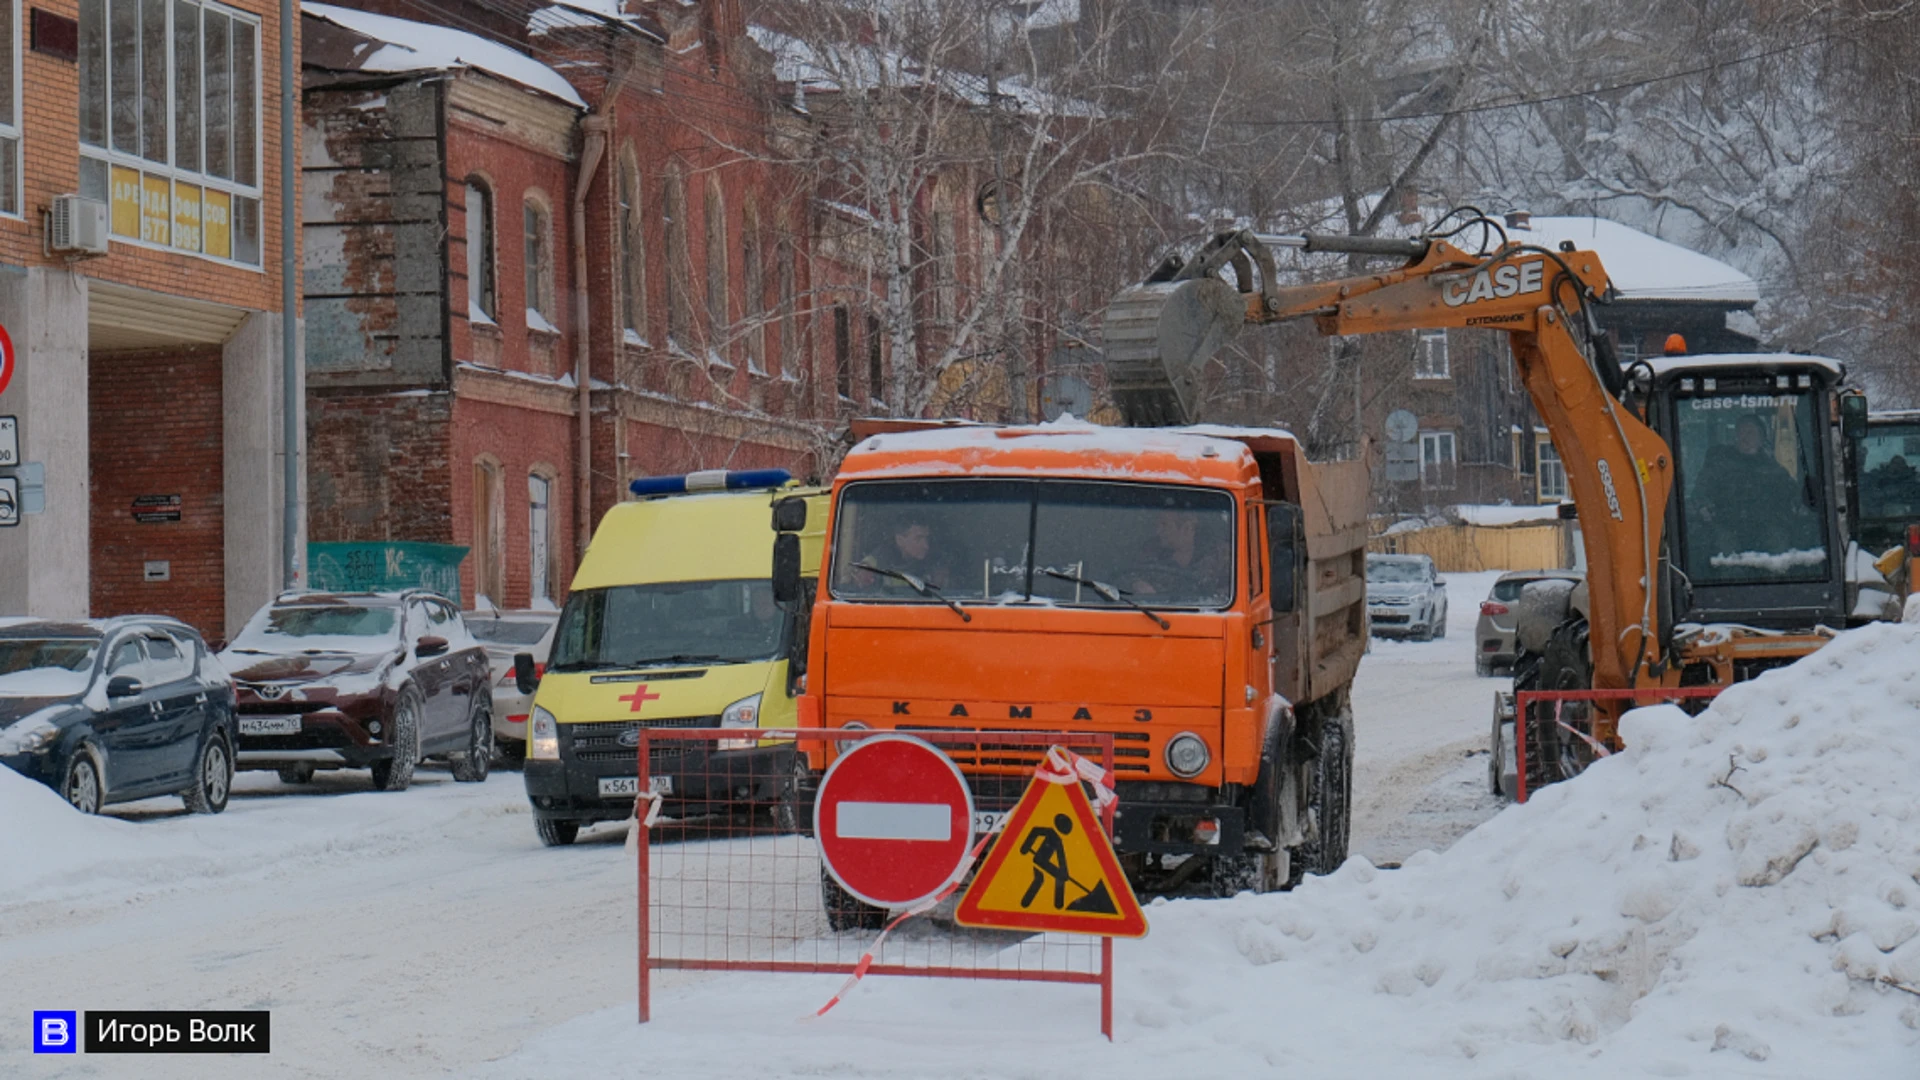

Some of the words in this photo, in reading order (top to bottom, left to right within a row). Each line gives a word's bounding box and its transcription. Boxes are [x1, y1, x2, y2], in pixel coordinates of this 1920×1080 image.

[115, 180, 168, 216] АРЕНДА
[143, 215, 169, 243] 577
[1442, 260, 1544, 307] CASE
[1692, 394, 1799, 410] case-tsm.ru
[892, 701, 1152, 722] КАМАЗ
